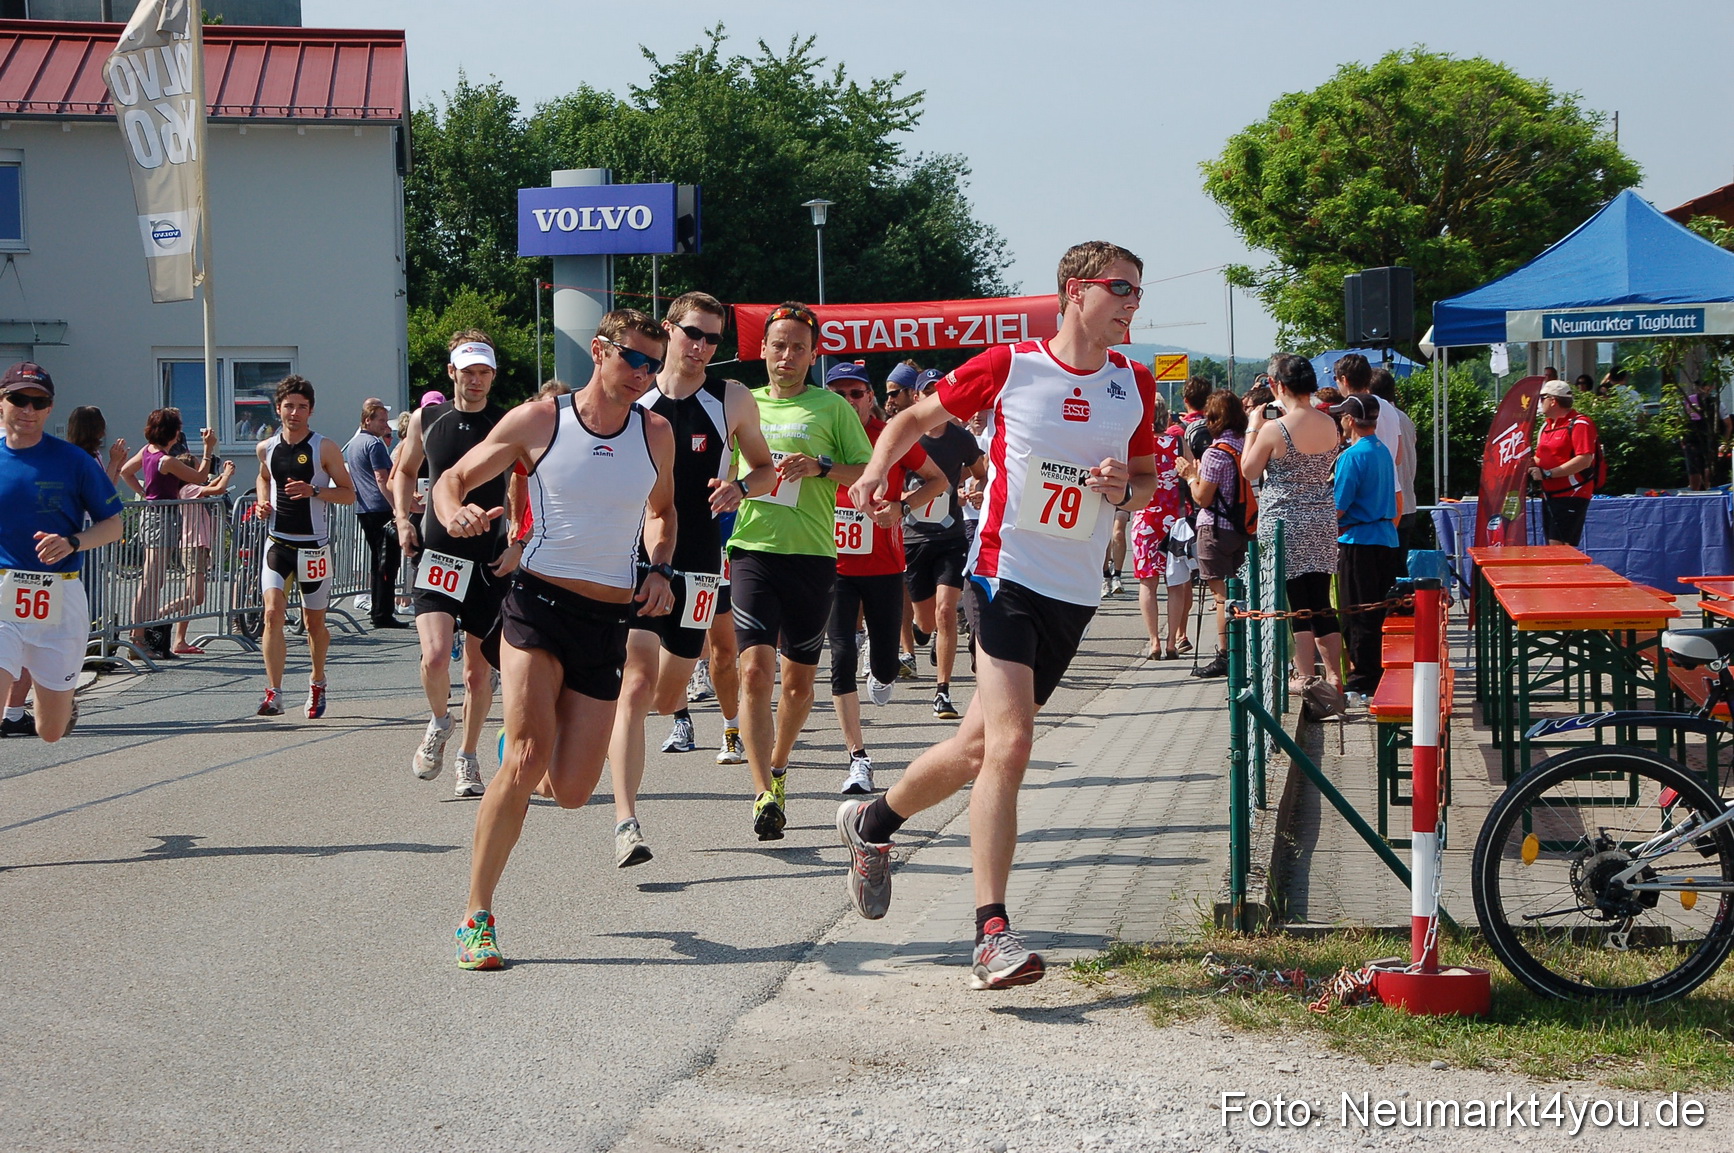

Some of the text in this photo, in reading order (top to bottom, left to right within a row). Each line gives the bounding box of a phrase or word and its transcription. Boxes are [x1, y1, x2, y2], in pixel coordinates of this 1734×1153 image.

[532, 205, 653, 232] VOLVO
[821, 313, 1043, 351] START+ZIEL
[1551, 313, 1697, 334] Neumarkter Tagblatt
[1040, 470, 1077, 483] WERBUNG
[1041, 461, 1077, 476] MEYER
[1039, 481, 1082, 529] 79
[834, 521, 862, 549] 58
[307, 558, 326, 579] 59
[431, 553, 455, 564] MEYER
[13, 571, 42, 582] MEYER
[427, 565, 459, 593] 80
[694, 574, 715, 584] MEYER
[15, 588, 50, 620] 56
[692, 589, 714, 623] 81
